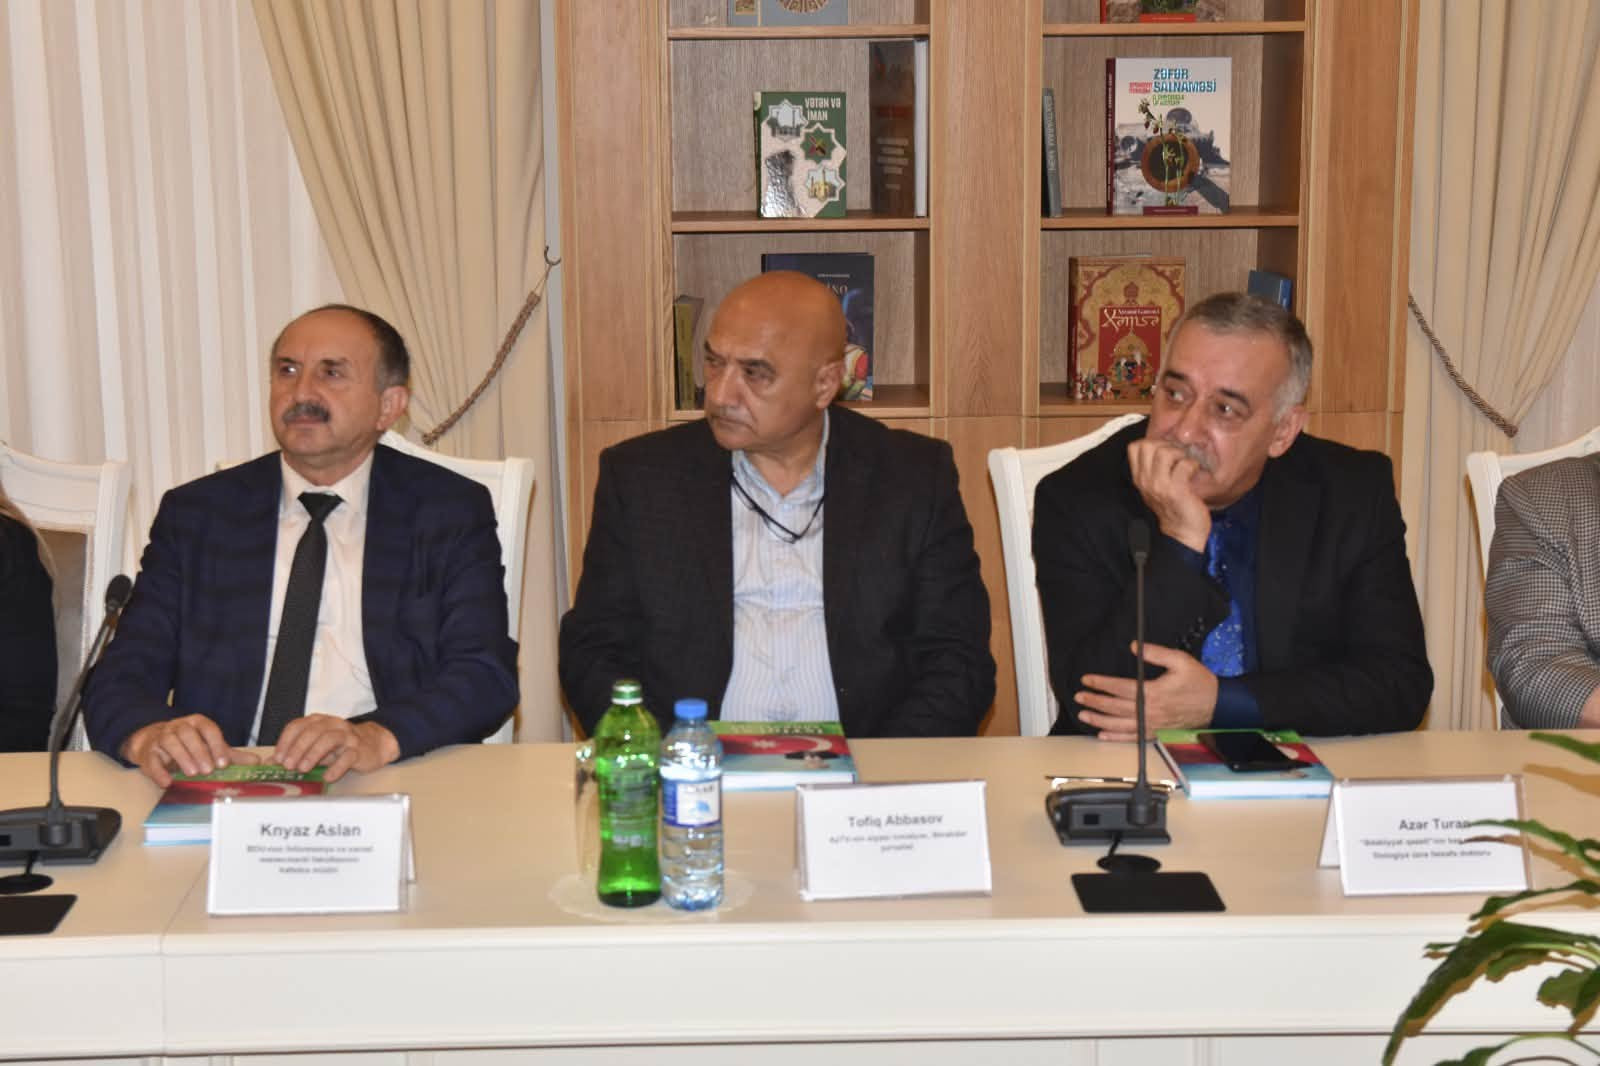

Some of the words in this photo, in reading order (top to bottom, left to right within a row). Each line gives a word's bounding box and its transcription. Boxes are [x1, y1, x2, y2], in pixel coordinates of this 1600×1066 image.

[848, 815, 882, 828] Tofiq
[885, 814, 943, 827] Abbasov
[1398, 819, 1429, 831] Azar
[260, 823, 311, 839] Knyaz
[315, 823, 362, 837] Aslan
